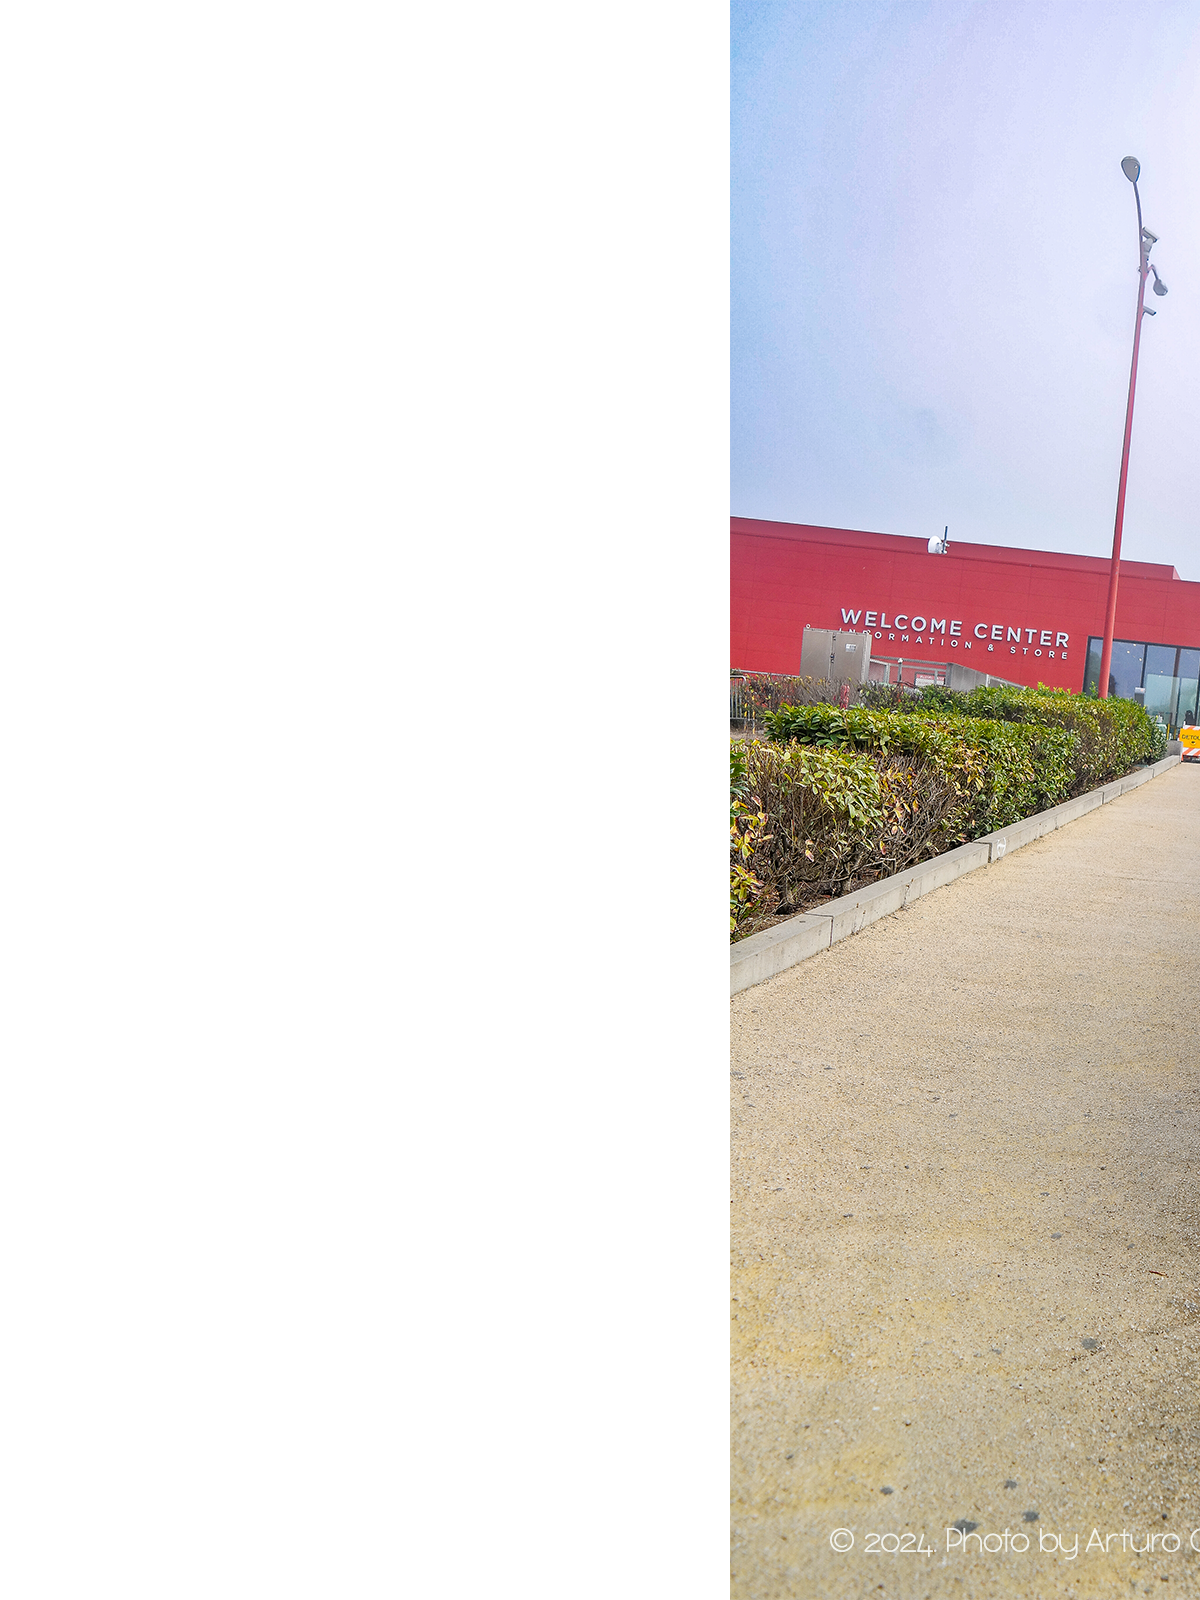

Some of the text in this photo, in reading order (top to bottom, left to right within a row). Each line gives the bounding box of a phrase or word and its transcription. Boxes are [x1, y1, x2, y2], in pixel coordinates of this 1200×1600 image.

[840, 607, 1070, 649] WELCOME CENTER
[987, 643, 995, 652] &
[1010, 646, 1068, 660] STORE
